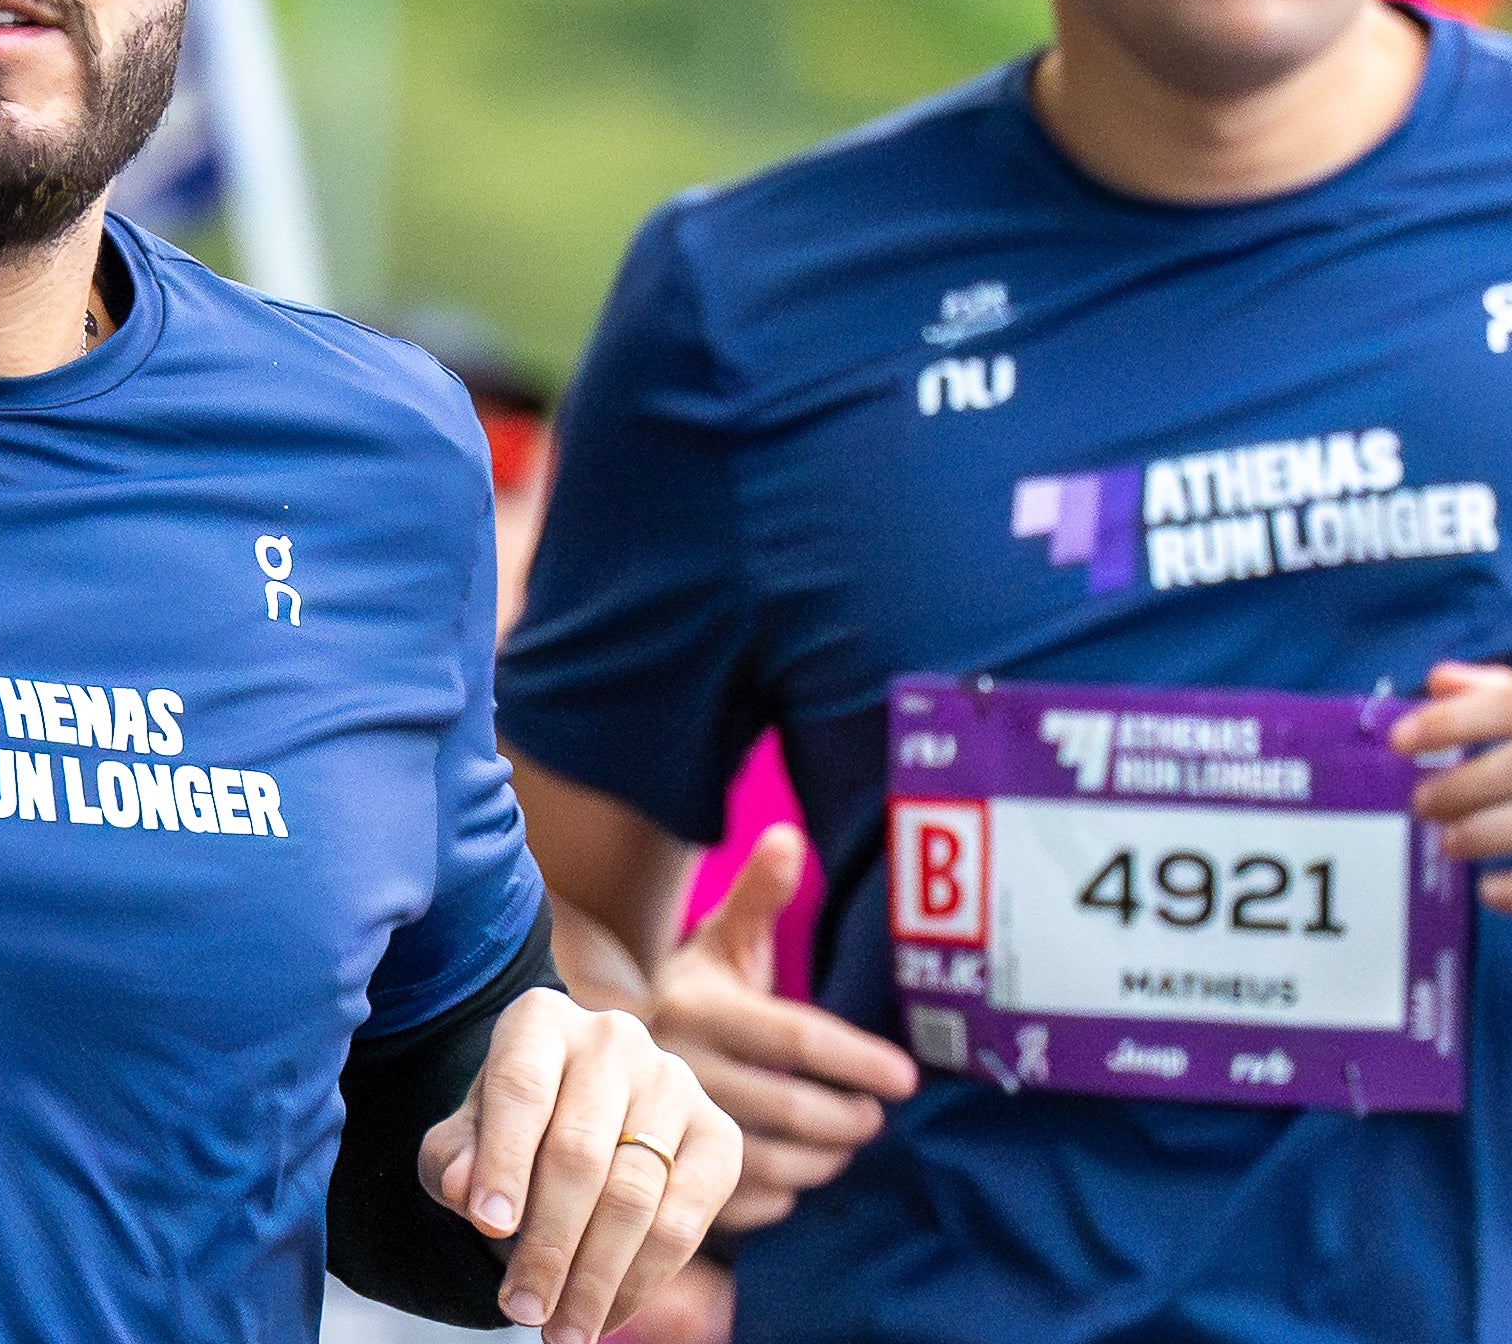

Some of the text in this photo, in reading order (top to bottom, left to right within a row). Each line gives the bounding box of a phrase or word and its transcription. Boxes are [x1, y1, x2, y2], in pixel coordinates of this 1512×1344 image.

[1144, 428, 1403, 525] ATHENAS
[1145, 482, 1499, 590] RUN LONGER
[62, 756, 289, 838] LONGER
[920, 823, 962, 920] B
[1078, 847, 1345, 938] 4921
[1119, 969, 1299, 1008] MATHEUS
